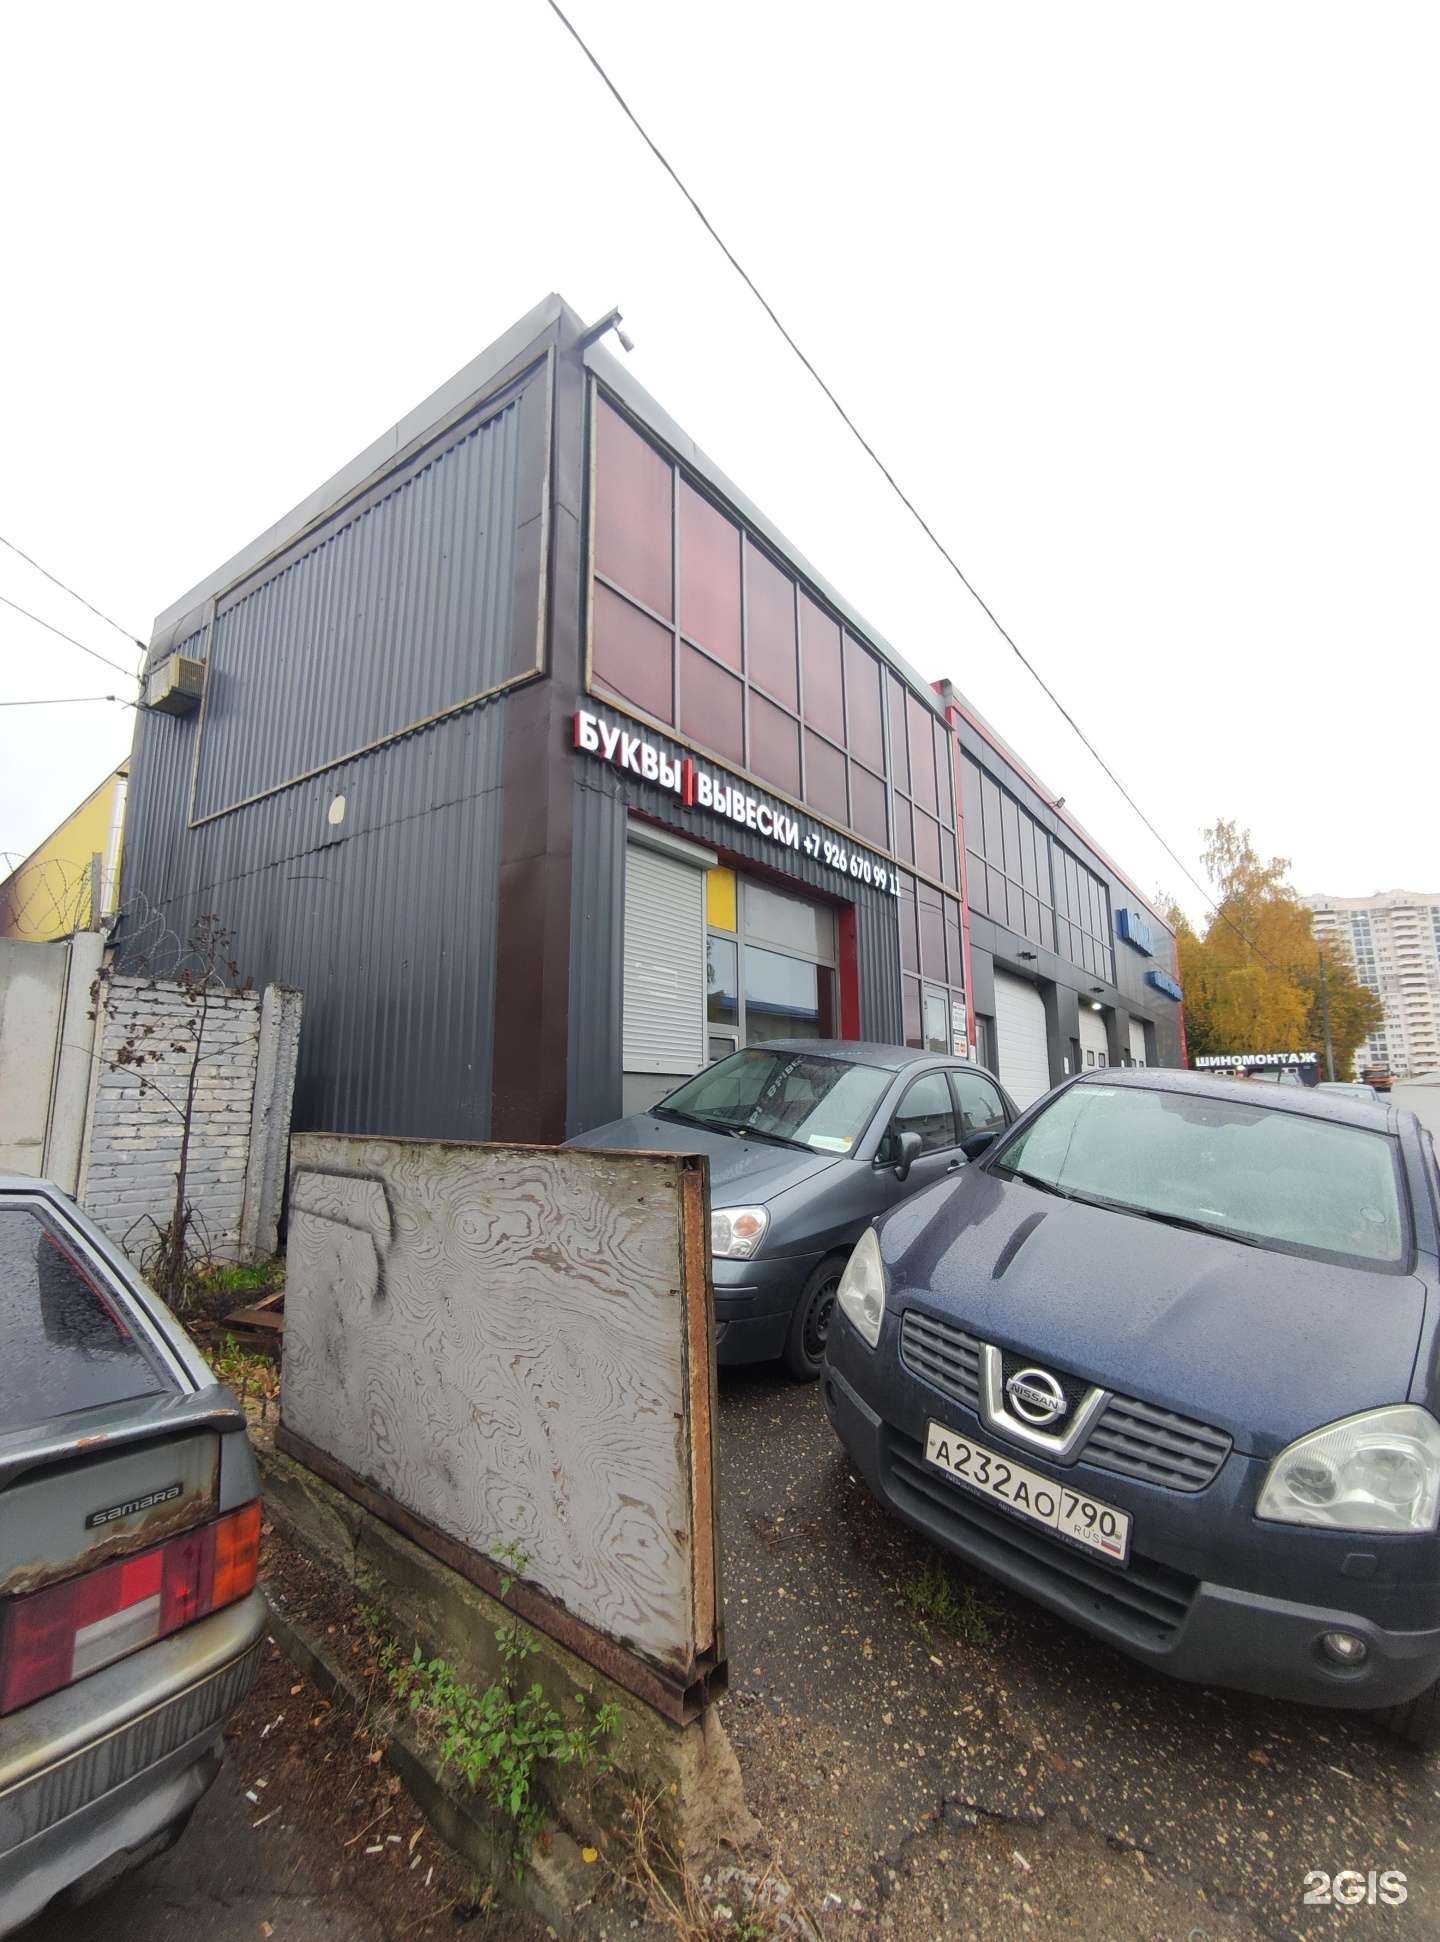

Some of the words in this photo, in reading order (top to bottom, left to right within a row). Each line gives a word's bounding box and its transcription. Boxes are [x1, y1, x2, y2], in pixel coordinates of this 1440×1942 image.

[574, 710, 682, 793] БУКВЫ
[696, 771, 800, 850] ВЫВЕСКИ
[803, 833, 820, 858] +7
[823, 840, 848, 872] 926
[850, 854, 871, 883] 670
[873, 865, 887, 890] 99
[890, 873, 901, 897] 11
[1195, 1052, 1318, 1067] ШИНОМОНТАЖ
[1011, 1383, 1059, 1409] NISSAN
[1064, 1492, 1116, 1537] 790
[1073, 1524, 1100, 1543] RUS
